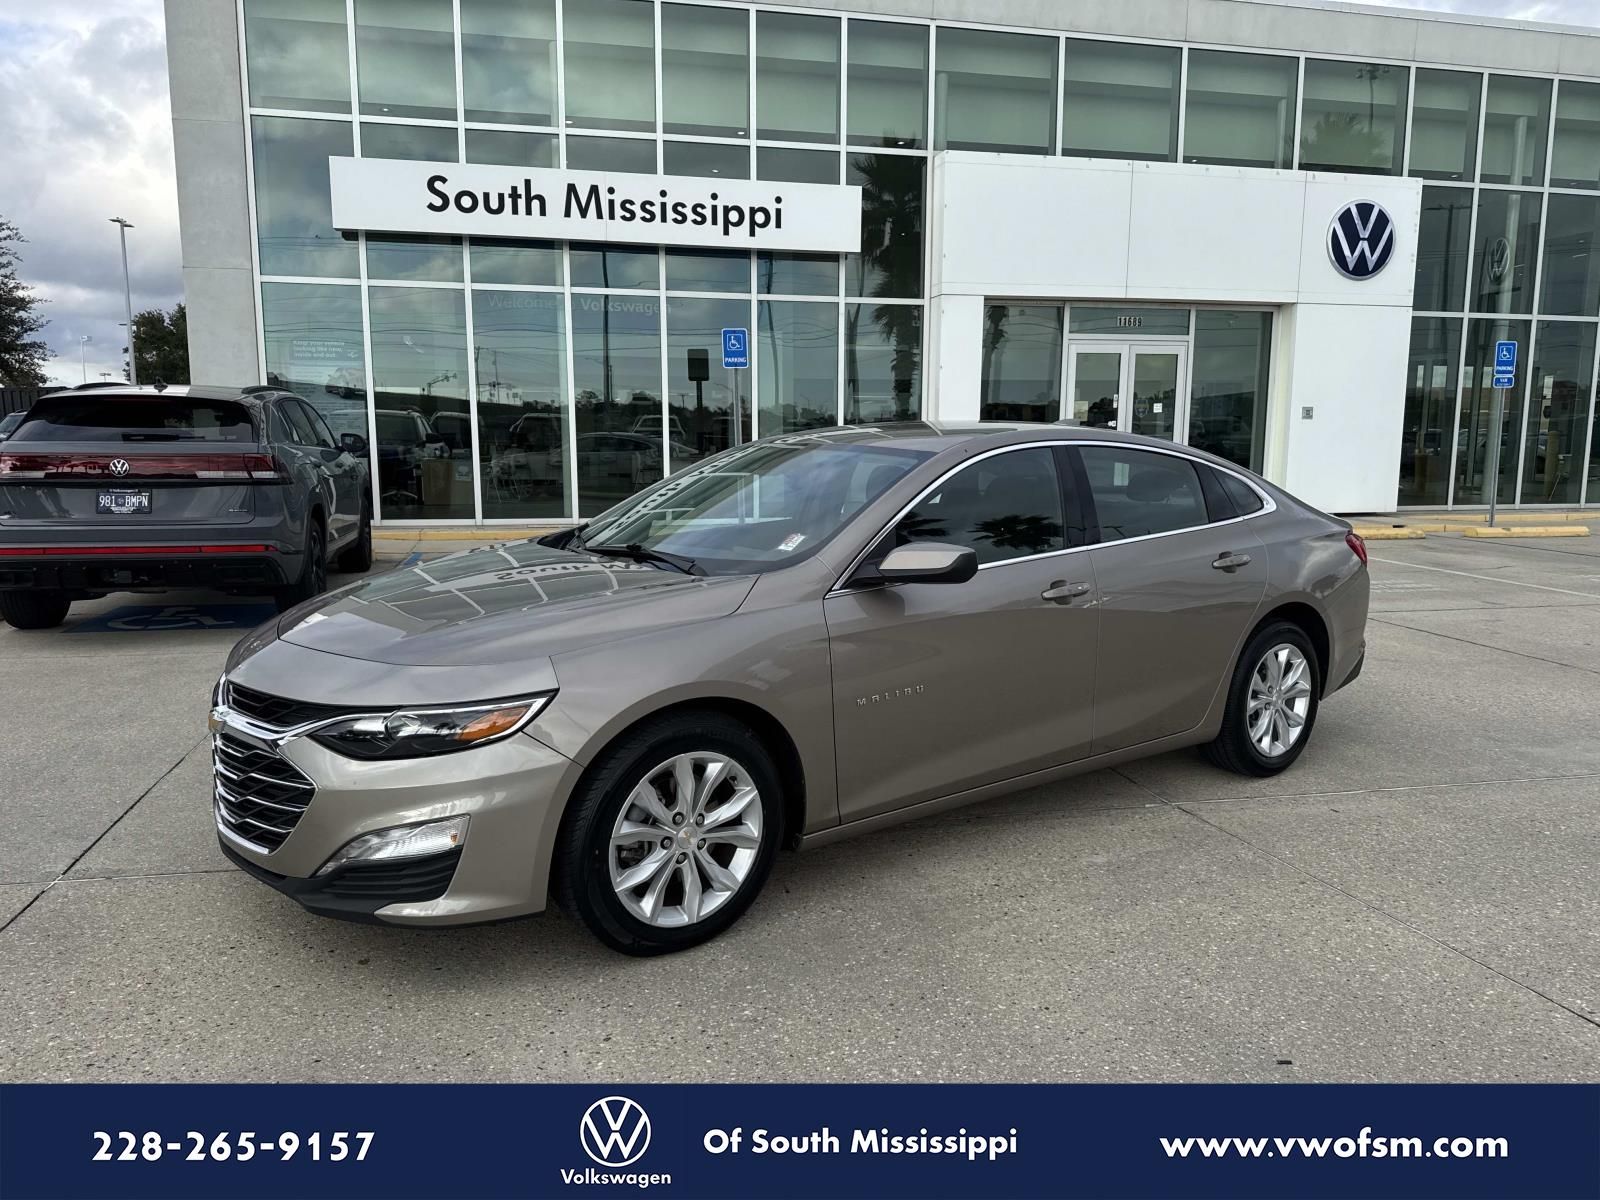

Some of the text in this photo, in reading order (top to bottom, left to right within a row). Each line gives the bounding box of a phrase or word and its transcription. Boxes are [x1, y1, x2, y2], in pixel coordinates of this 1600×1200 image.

[425, 174, 783, 237] South Mississippi
[487, 294, 556, 310] Welcome
[580, 297, 672, 316] Volkswagen
[99, 495, 149, 507] 981 BMPN
[856, 684, 925, 707] MALIBU
